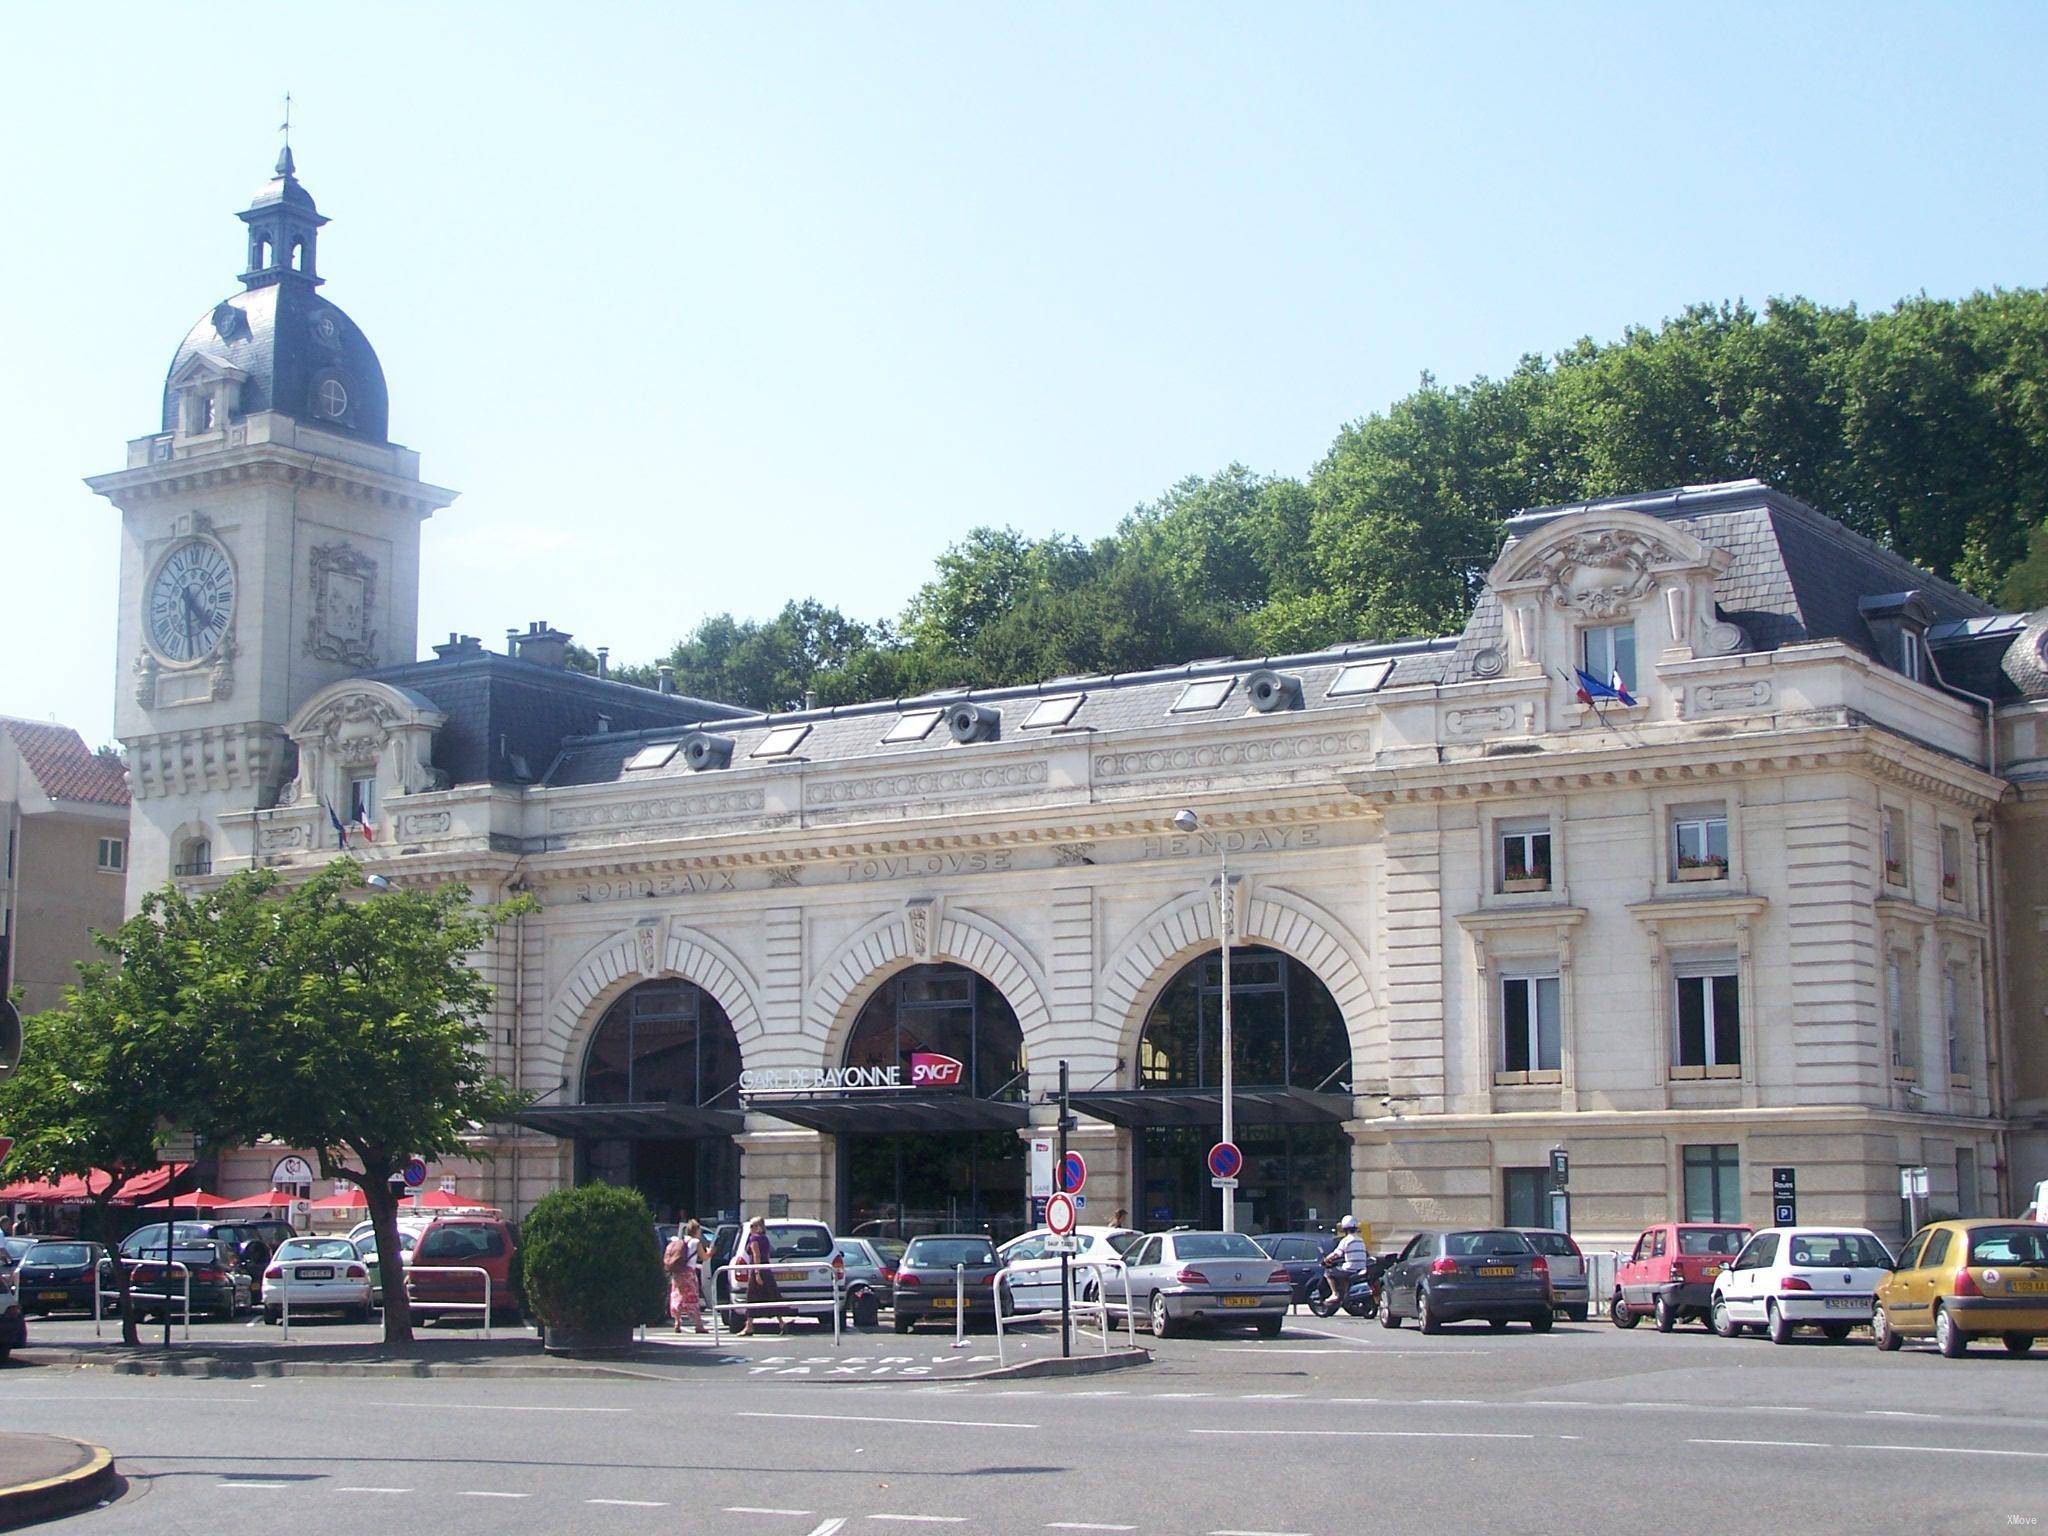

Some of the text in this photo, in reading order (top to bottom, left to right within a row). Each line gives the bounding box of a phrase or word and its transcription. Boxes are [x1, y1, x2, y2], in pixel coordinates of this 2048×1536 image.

[1142, 823, 1321, 858] HENDAYE
[739, 1066, 900, 1089] GARE DE BAYONNE
[912, 1064, 957, 1081] SNCF
[717, 1356, 1000, 1364] RESERVE
[748, 1366, 933, 1375] TAXIS
